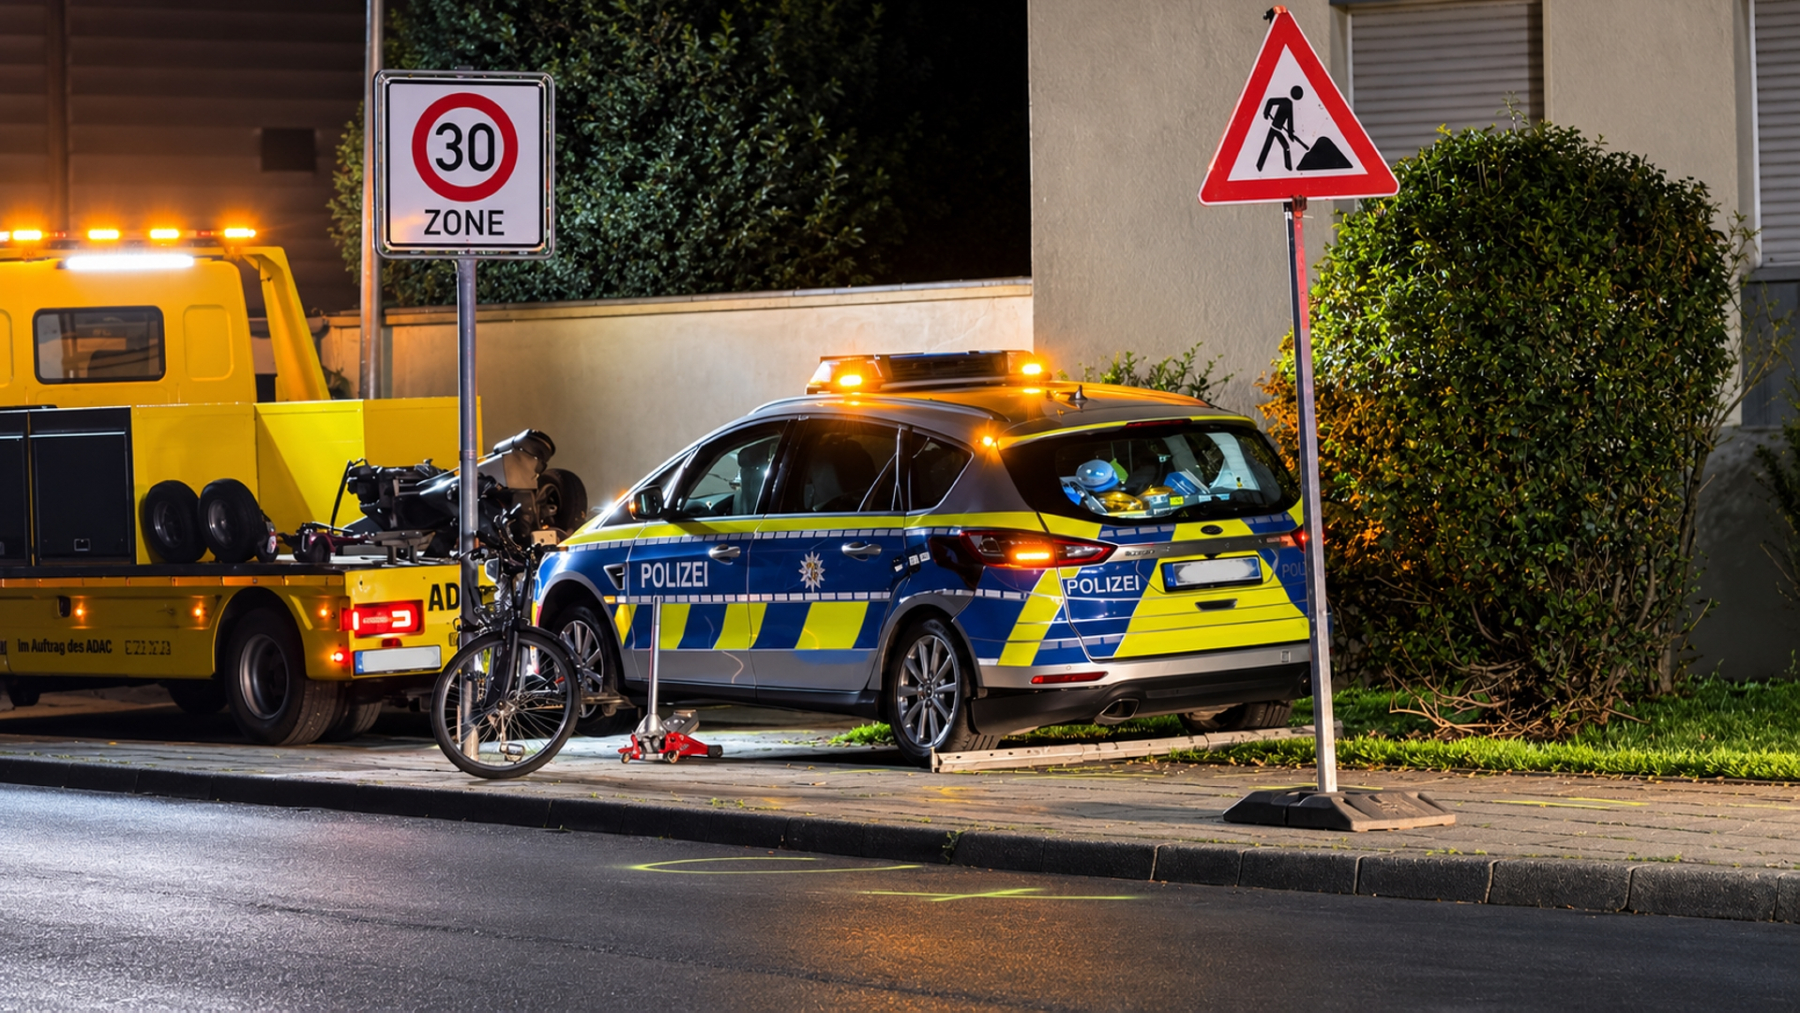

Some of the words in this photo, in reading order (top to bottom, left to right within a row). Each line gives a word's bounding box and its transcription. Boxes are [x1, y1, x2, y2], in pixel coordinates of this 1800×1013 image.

[435, 122, 495, 172] 30
[424, 209, 504, 236] ZONE
[641, 561, 709, 588] POLIZEI
[1066, 574, 1140, 596] POLIZEI
[428, 582, 461, 611] AD
[31, 638, 65, 656] Auftrag
[67, 638, 84, 653] des
[86, 639, 112, 654] ADAC
